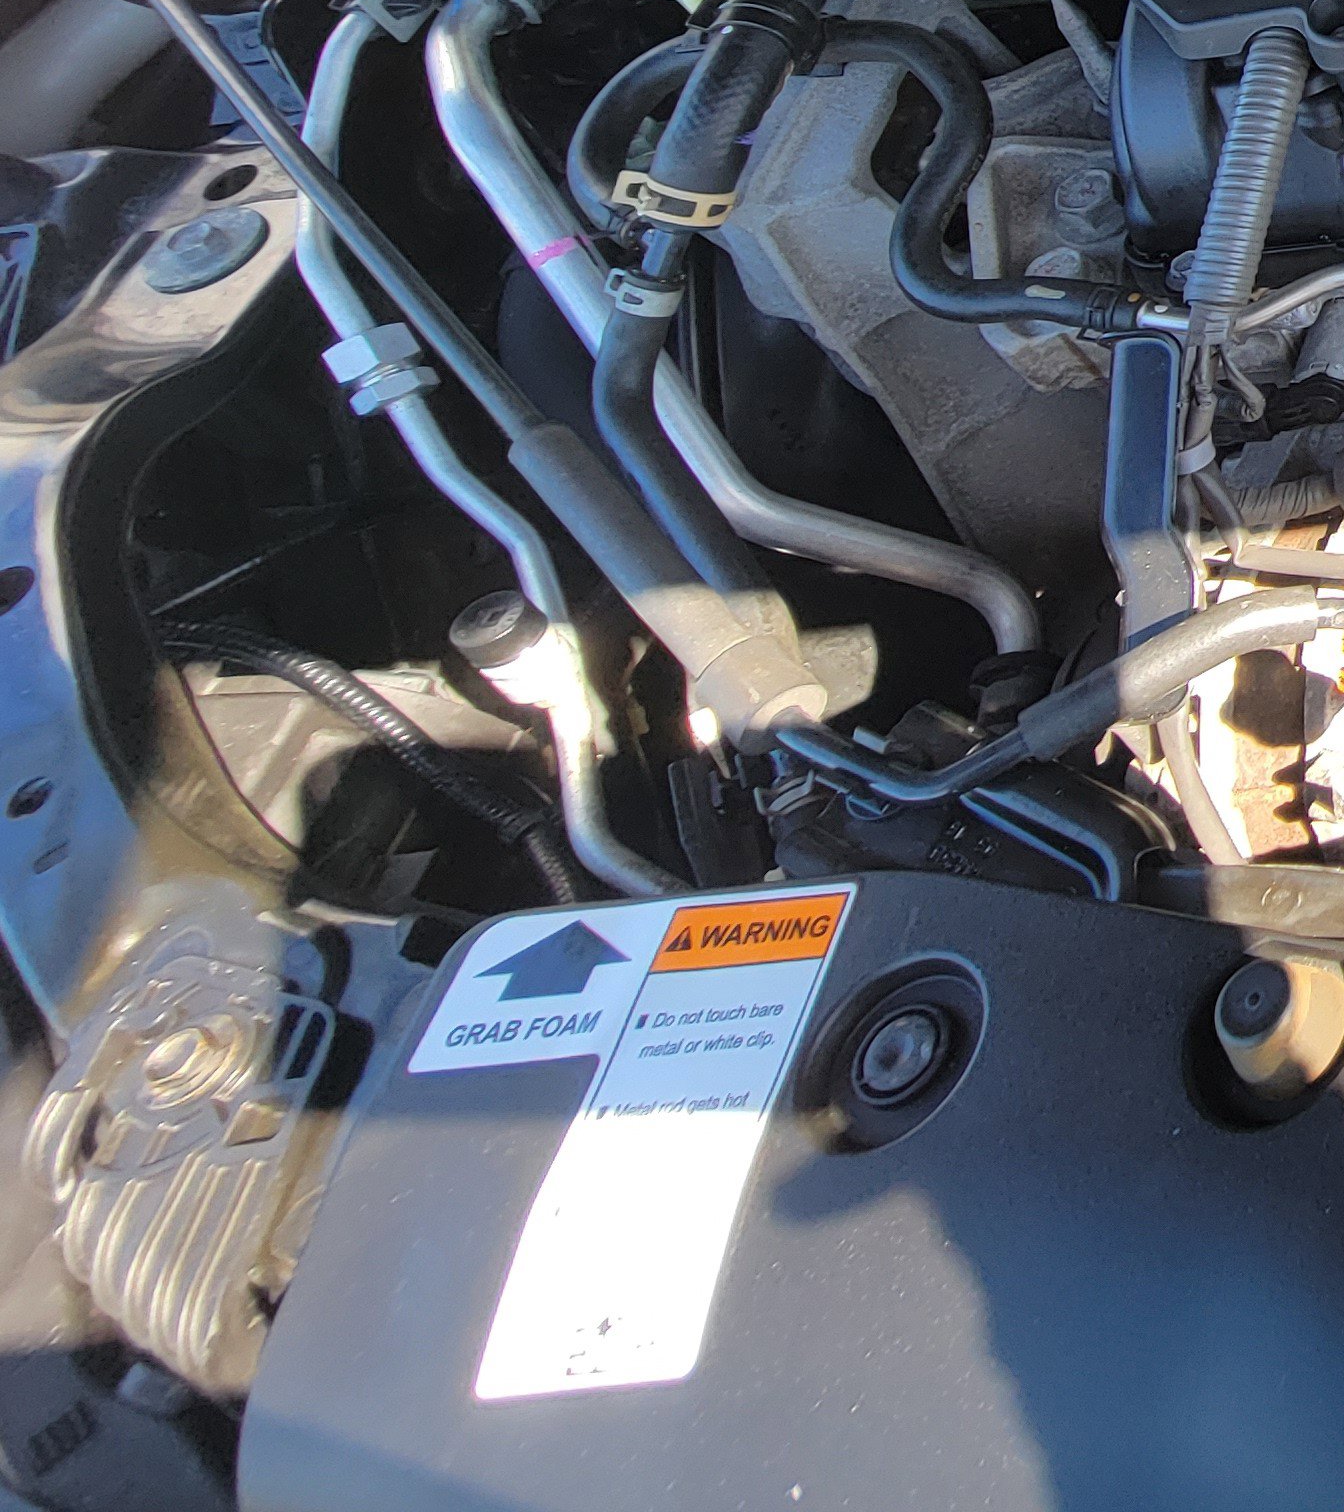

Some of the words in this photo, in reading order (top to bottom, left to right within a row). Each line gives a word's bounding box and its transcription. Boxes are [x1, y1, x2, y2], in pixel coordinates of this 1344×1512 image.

[700, 914, 830, 949] WARNING
[446, 1018, 521, 1048] GRAB
[524, 1010, 603, 1042] FOAM
[652, 1012, 675, 1029] Do
[677, 1009, 704, 1025] not
[704, 1004, 746, 1024] touch
[748, 1002, 784, 1019] bare
[638, 1039, 683, 1059] metal
[683, 1039, 703, 1054] or
[702, 1033, 744, 1052] white
[746, 1029, 776, 1050] clip.
[613, 1099, 658, 1118] Metal
[657, 1096, 687, 1114] rod
[687, 1095, 721, 1116] gets
[722, 1090, 750, 1109] hot
